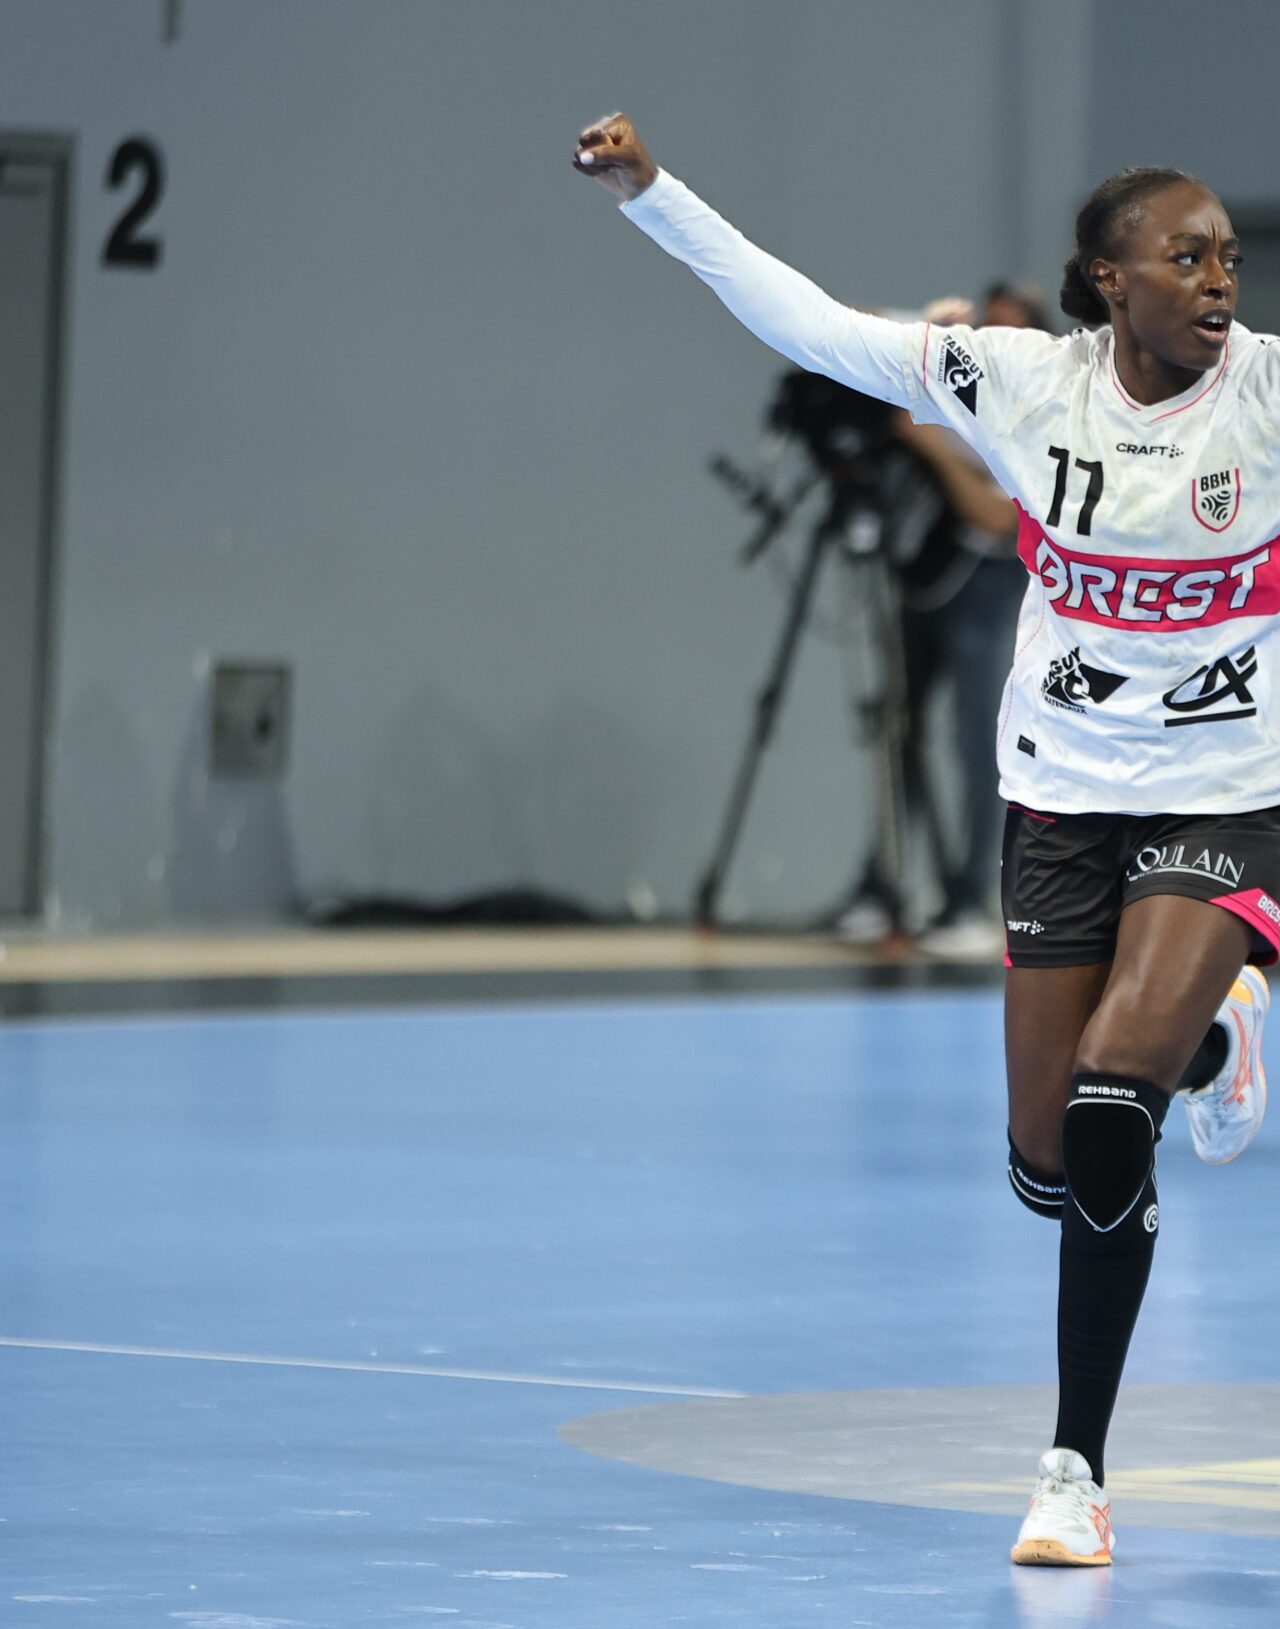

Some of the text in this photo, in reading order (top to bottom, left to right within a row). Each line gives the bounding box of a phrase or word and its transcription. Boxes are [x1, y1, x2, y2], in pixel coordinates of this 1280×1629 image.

[103, 134, 167, 271] 2
[943, 335, 985, 380] TANGUY
[1116, 443, 1168, 456] CRAFT
[1200, 470, 1231, 491] BBH
[1035, 538, 1271, 623] BREST
[1126, 845, 1245, 883] OULAIN
